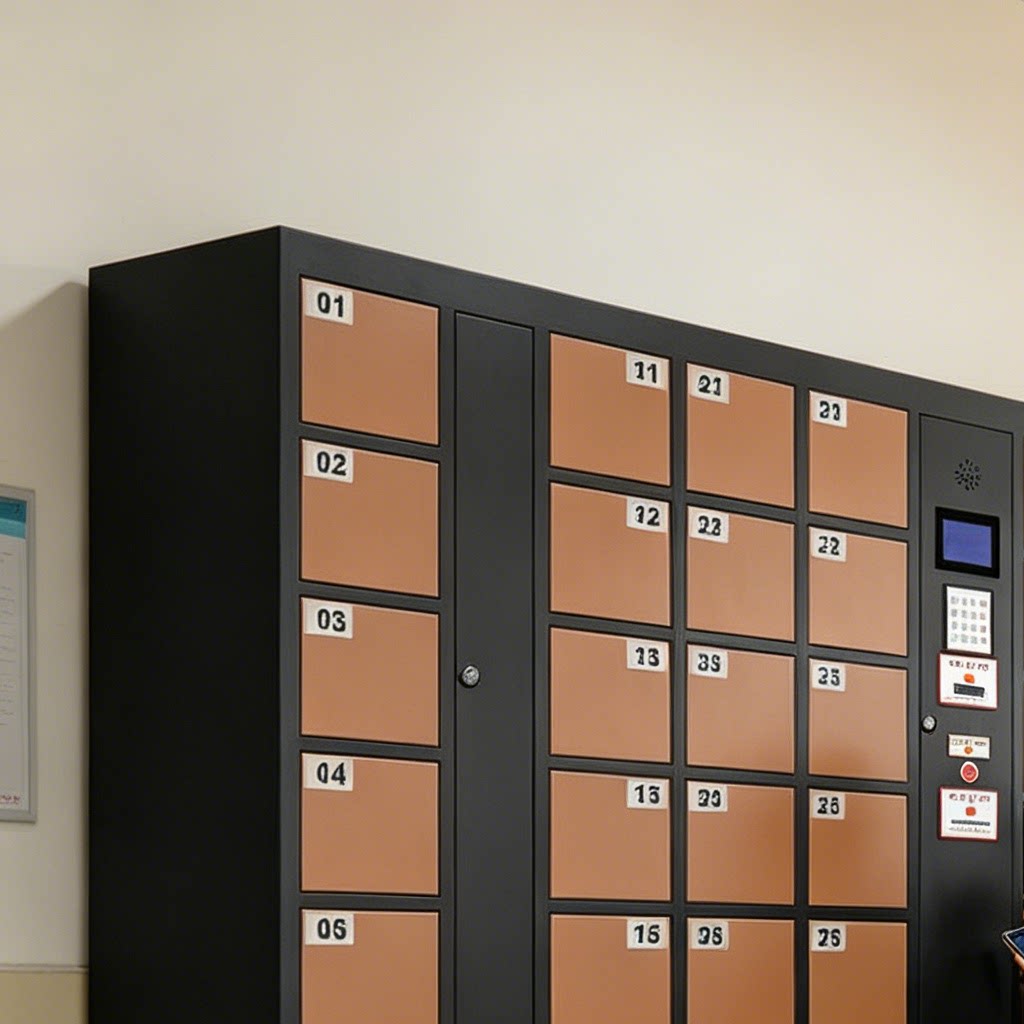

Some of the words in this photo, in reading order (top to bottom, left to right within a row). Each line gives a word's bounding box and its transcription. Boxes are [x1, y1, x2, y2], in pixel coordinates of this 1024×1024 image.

[317, 291, 344, 318] 01
[633, 361, 658, 385] 11
[316, 451, 347, 477] 02
[635, 505, 660, 527] 12
[317, 608, 346, 633] 03
[316, 762, 347, 786] 04
